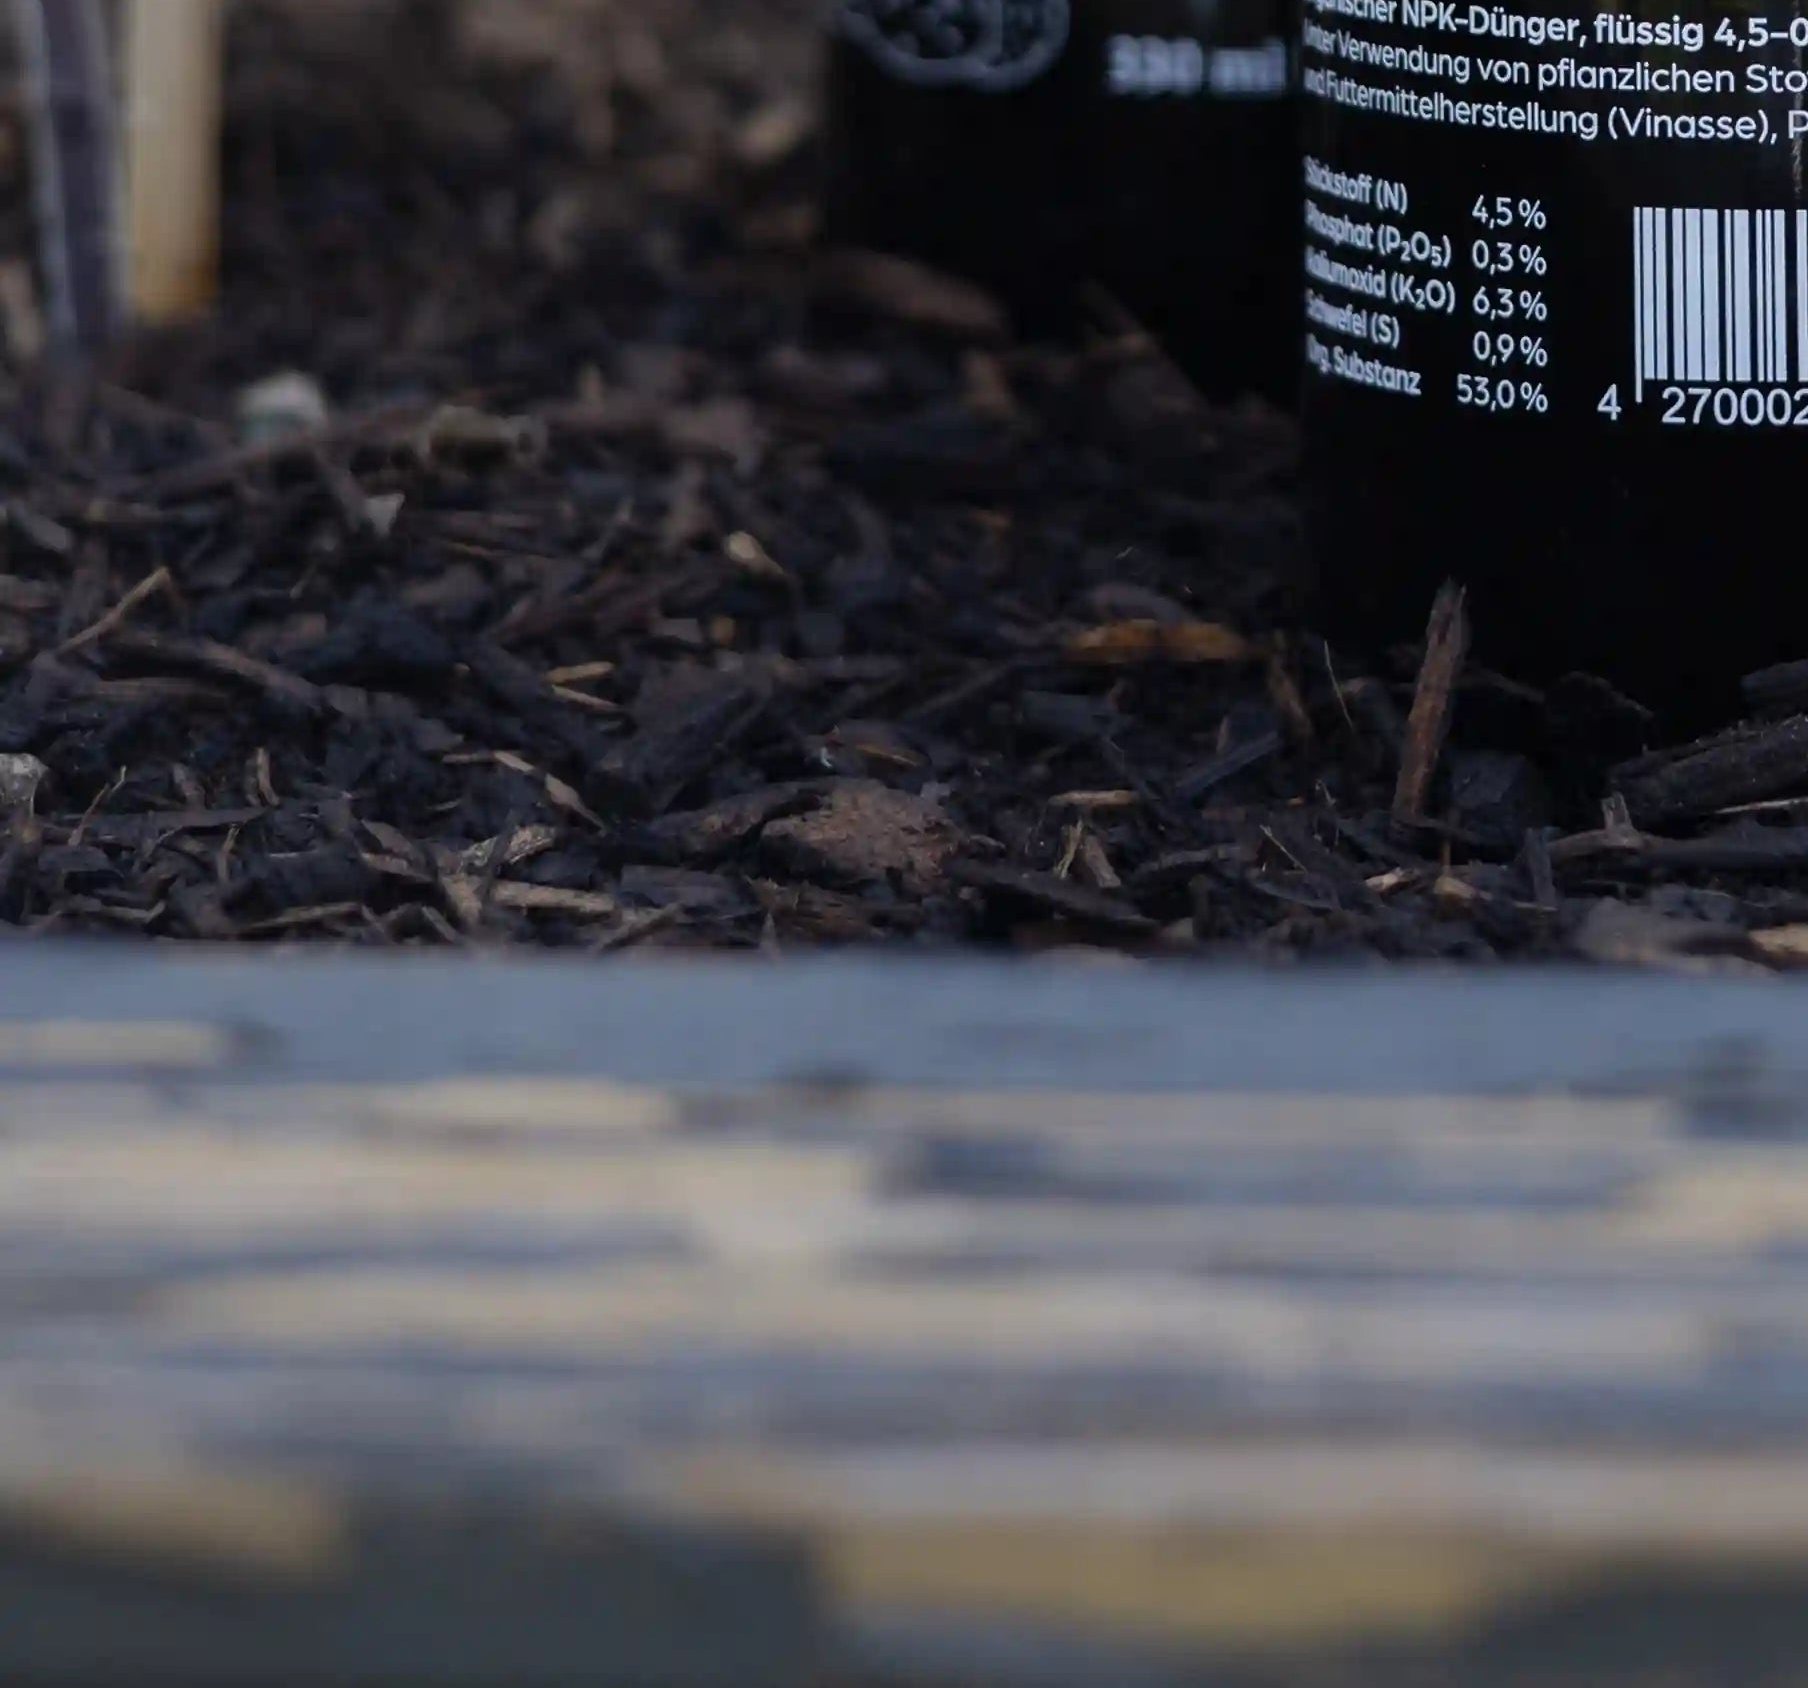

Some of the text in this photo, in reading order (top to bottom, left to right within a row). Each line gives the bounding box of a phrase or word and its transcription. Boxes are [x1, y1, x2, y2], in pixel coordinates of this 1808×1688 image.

[1595, 13, 1704, 52] flüssig
[1337, 28, 1470, 84] Verwendung
[1476, 57, 1530, 85] von
[1537, 60, 1734, 93] pflanzlichen
[1326, 69, 1599, 140] Futtermittelherstellung
[1607, 106, 1778, 144] (Vinasse),
[1376, 178, 1408, 215] (N)
[1471, 194, 1513, 229] 4,5
[1518, 198, 1547, 230] %
[1471, 238, 1514, 276] 0,3
[1518, 246, 1547, 276] %
[1472, 287, 1516, 322] 6,3
[1519, 290, 1548, 322] %
[1371, 311, 1400, 350] (S)
[1472, 329, 1516, 367] 0,9
[1520, 336, 1548, 368] %
[1333, 345, 1422, 396] Substanz
[1456, 373, 1516, 411] 53,0
[1520, 382, 1548, 413] %
[1597, 383, 1623, 421] 4
